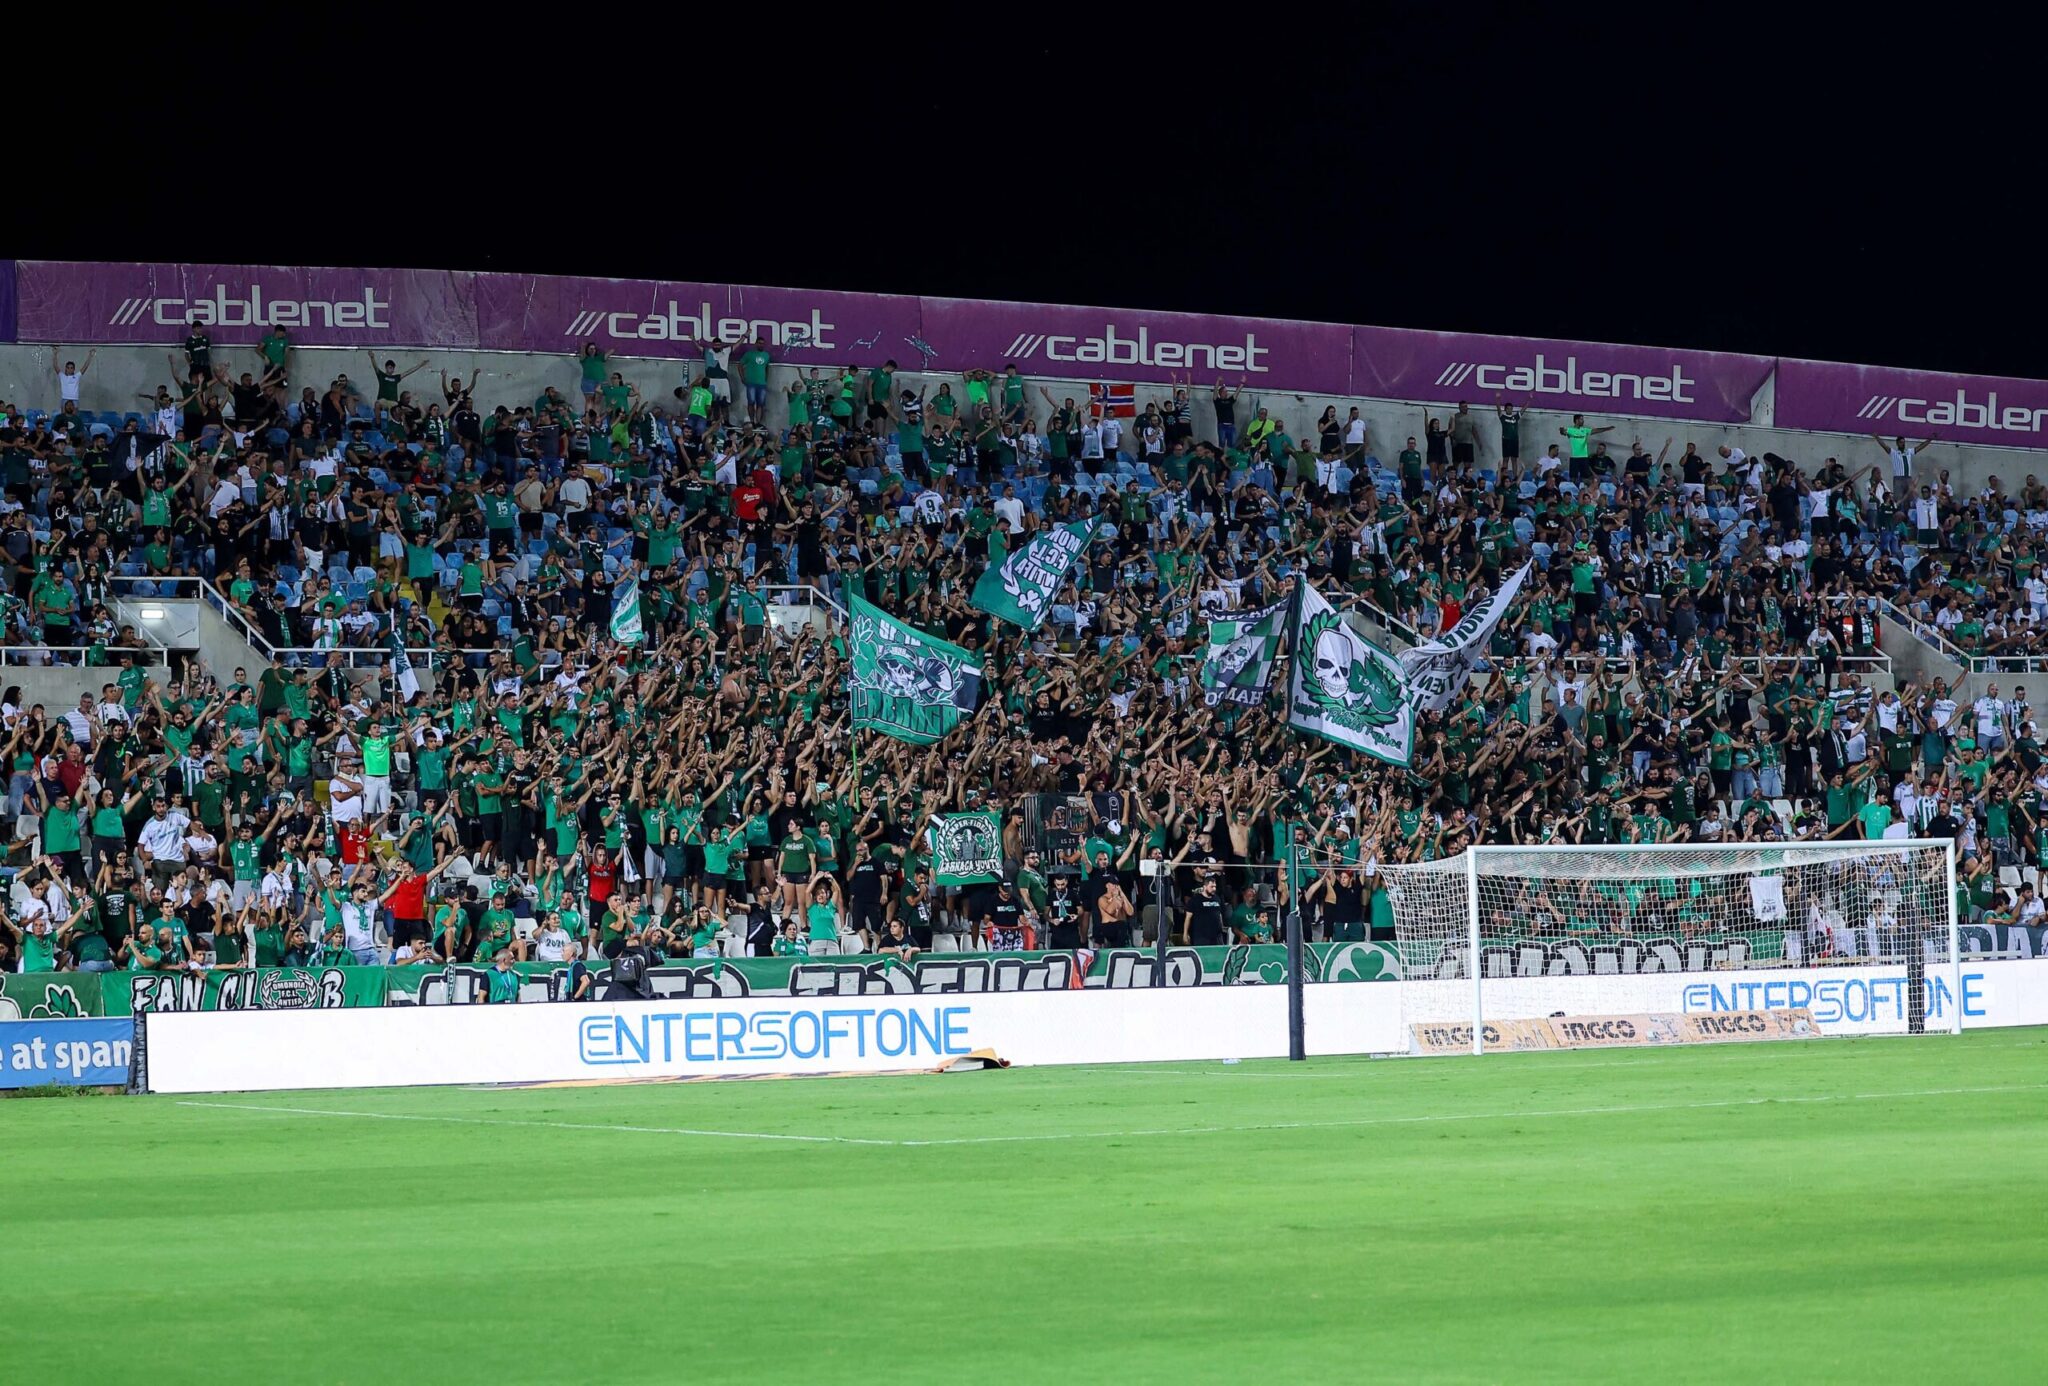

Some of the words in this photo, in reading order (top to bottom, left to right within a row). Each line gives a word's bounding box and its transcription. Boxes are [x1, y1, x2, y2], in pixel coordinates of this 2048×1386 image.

[153, 283, 390, 329] cablenet
[607, 299, 836, 350] cablenet
[1045, 323, 1269, 374] cablenet
[1475, 353, 1696, 404] cablenet
[925, 499, 936, 513] 9
[131, 973, 206, 1013] FAN
[271, 981, 306, 991] OMONOIA
[11, 1035, 48, 1071] at
[578, 1005, 972, 1066] ENTERSOFTONE
